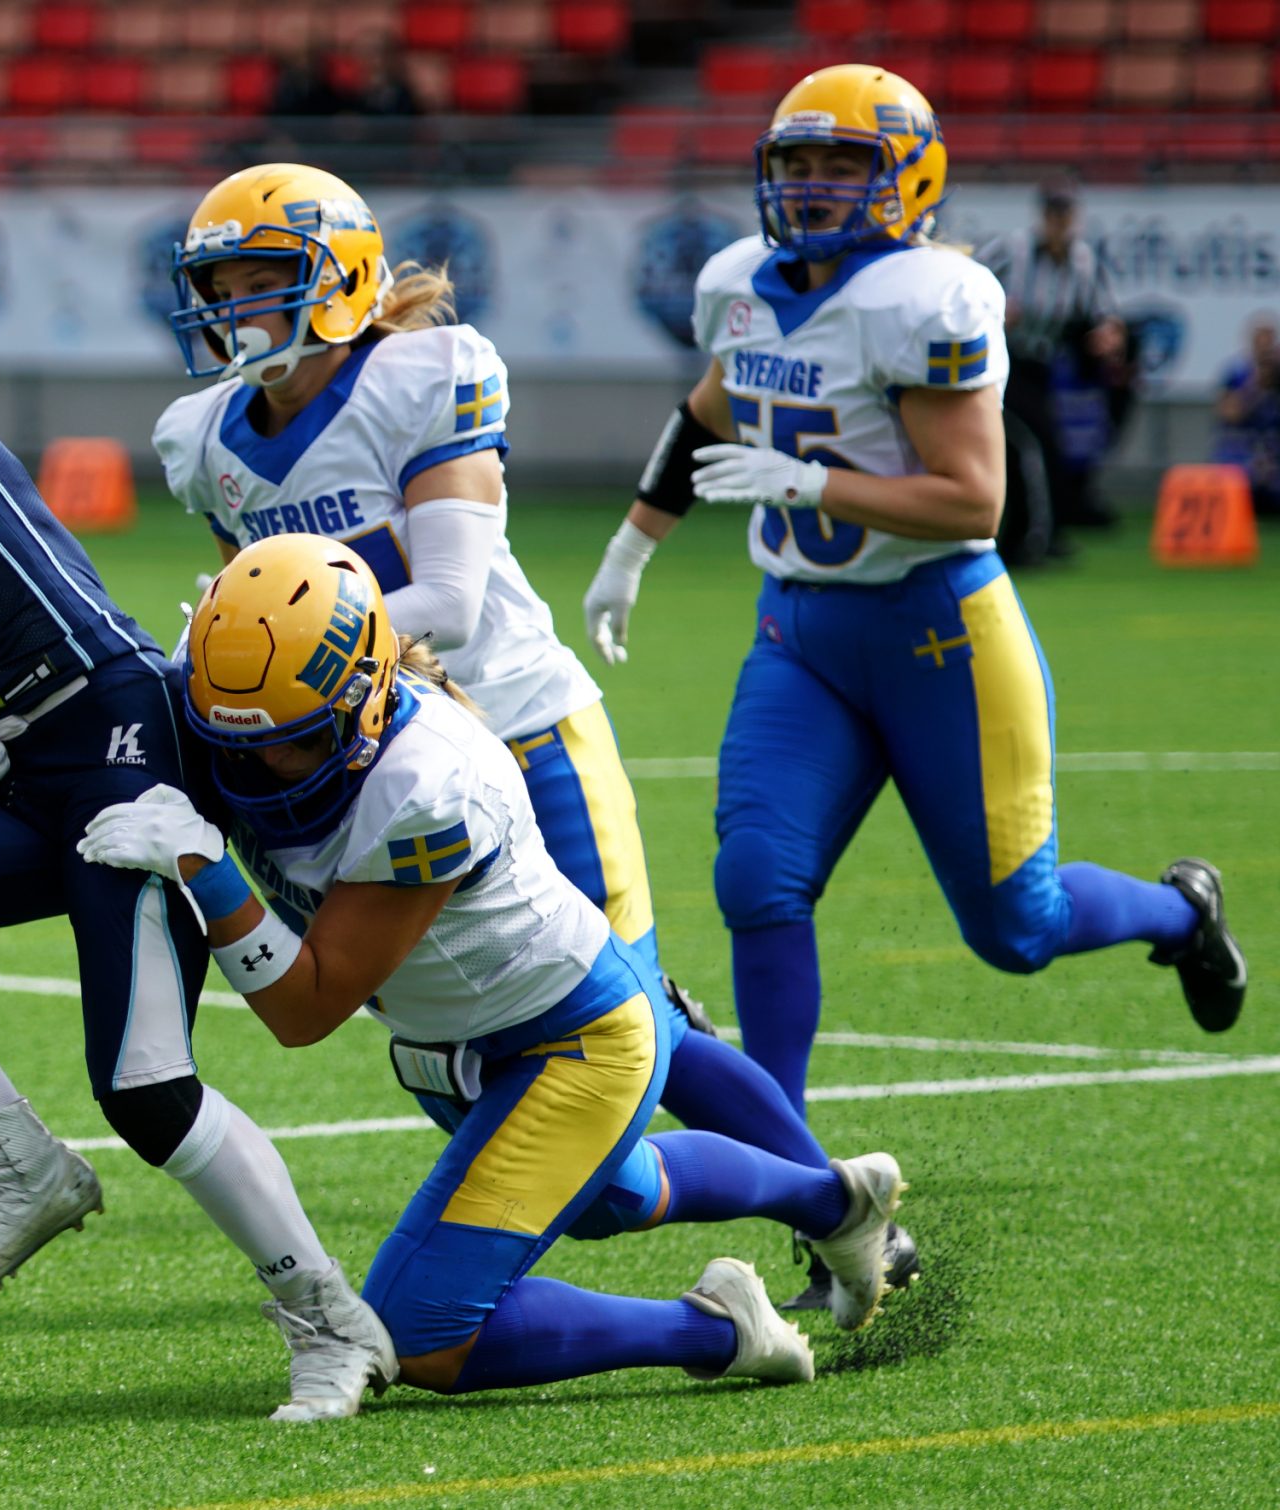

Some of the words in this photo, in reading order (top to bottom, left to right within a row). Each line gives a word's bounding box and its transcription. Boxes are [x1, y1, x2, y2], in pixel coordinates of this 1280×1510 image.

[735, 350, 824, 399] SVERIGE
[241, 488, 366, 544] SVERIGE
[296, 571, 370, 699] SWE
[105, 723, 146, 759] K
[214, 711, 262, 725] Riddell
